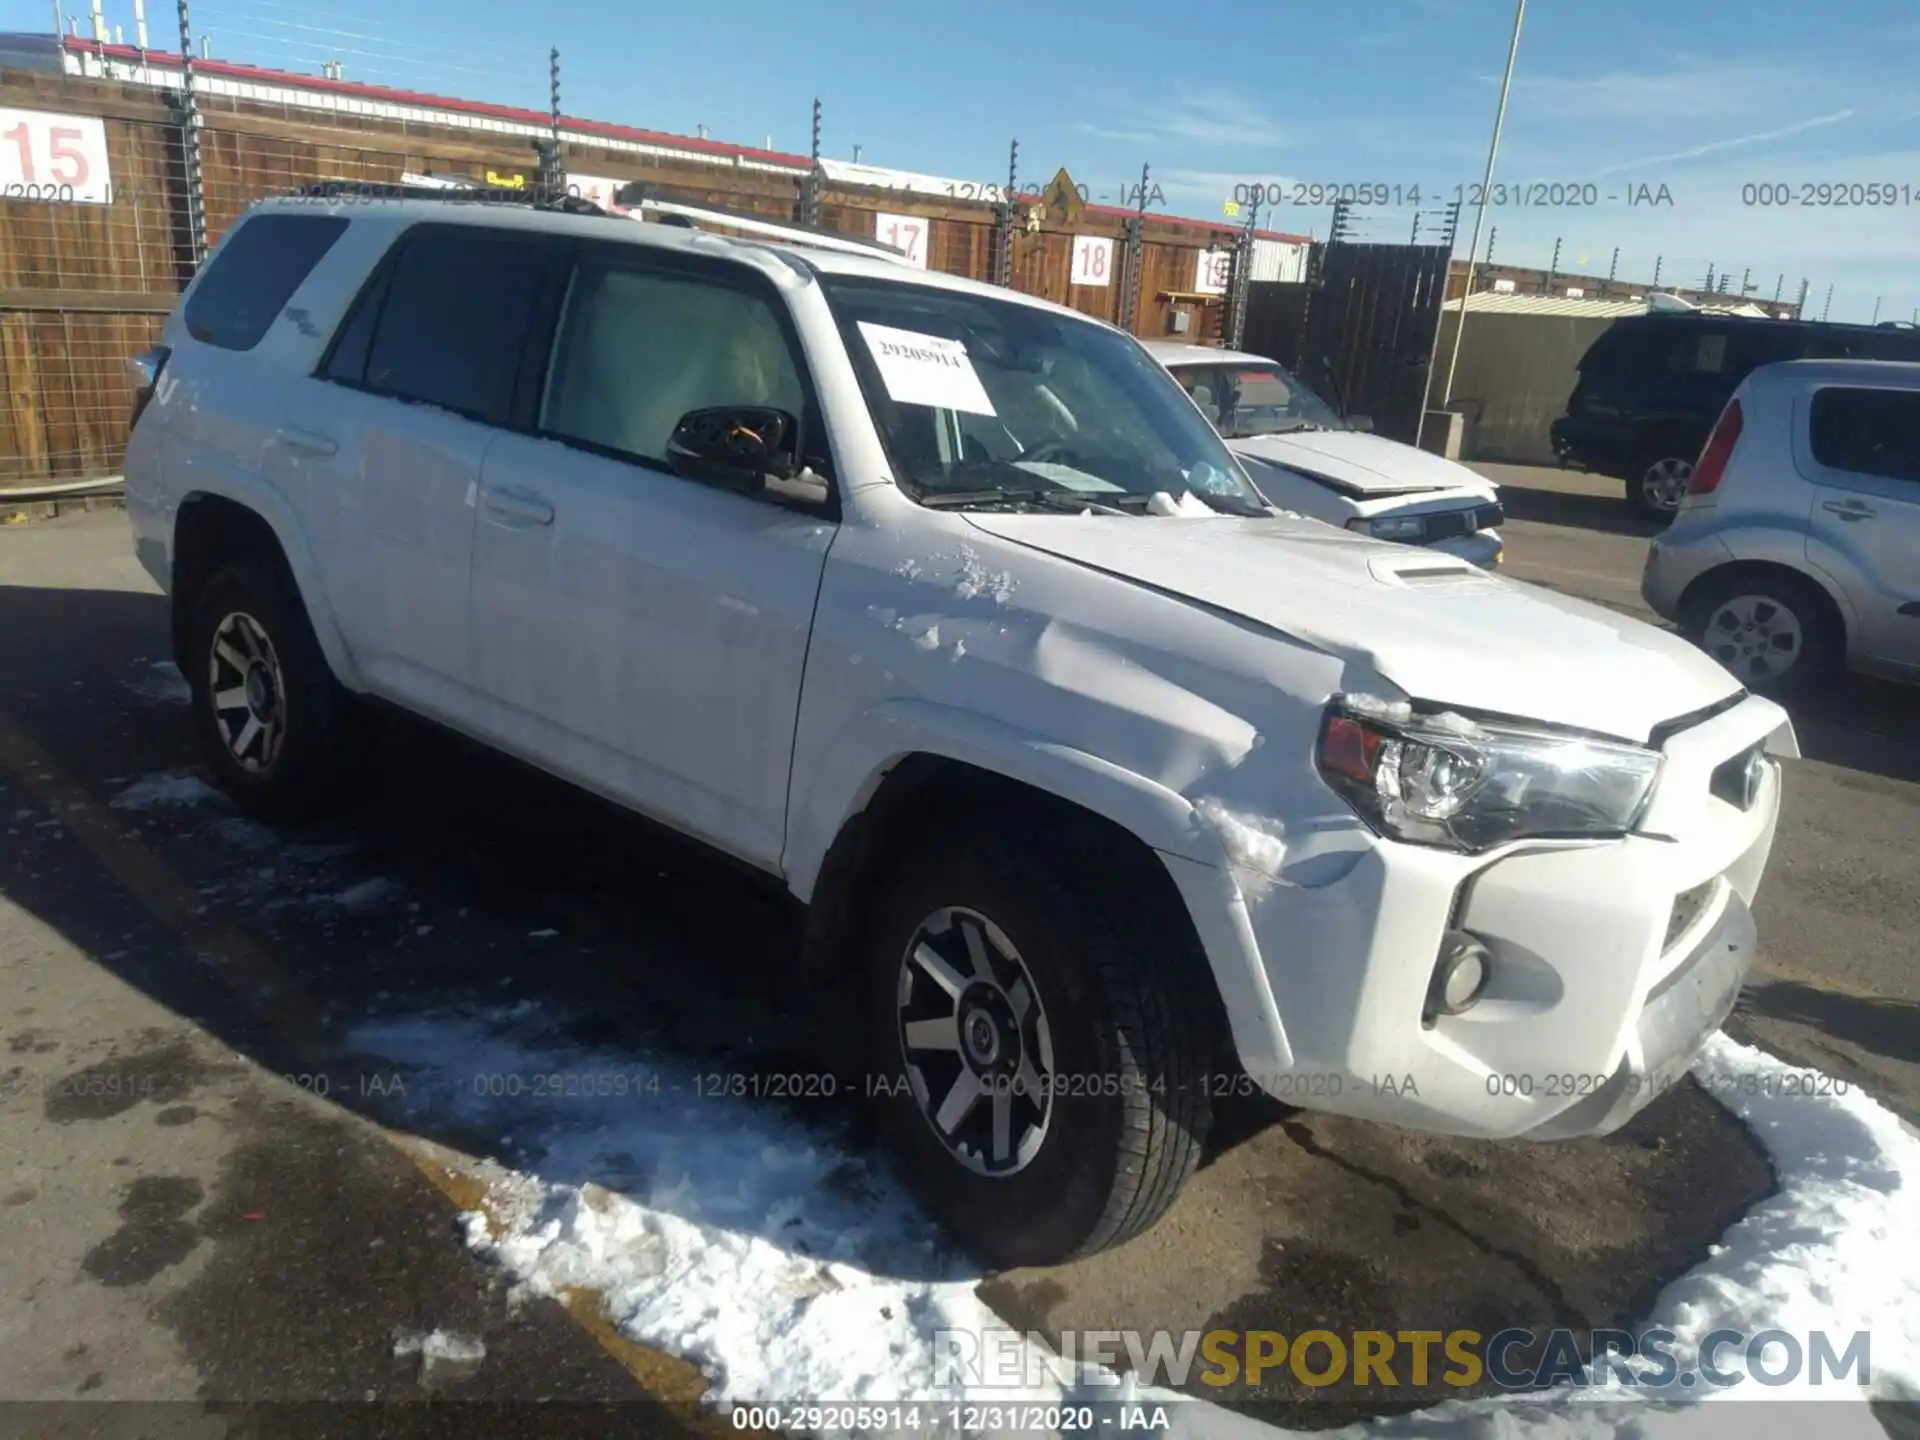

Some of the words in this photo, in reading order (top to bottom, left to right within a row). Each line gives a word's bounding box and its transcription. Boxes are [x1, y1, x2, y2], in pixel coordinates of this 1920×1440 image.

[4, 122, 89, 187] 15
[887, 222, 921, 259] 17
[1081, 244, 1106, 278] 18
[879, 341, 961, 369] 29205914
